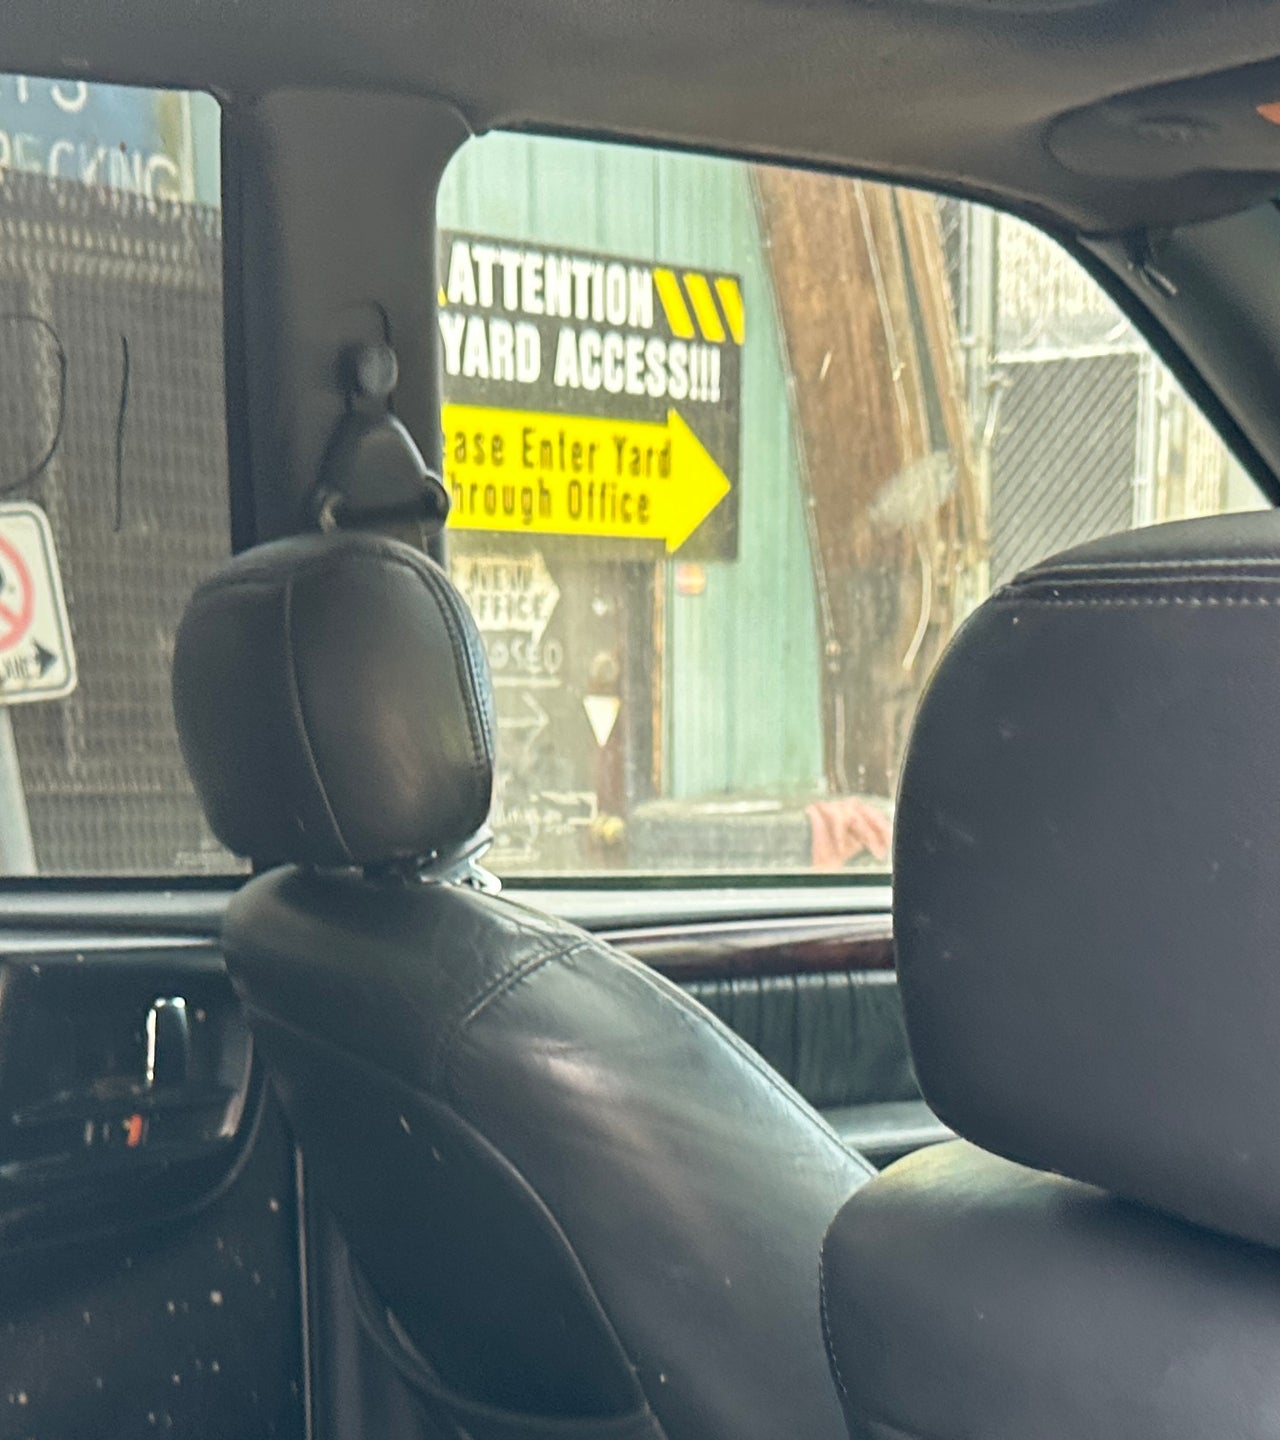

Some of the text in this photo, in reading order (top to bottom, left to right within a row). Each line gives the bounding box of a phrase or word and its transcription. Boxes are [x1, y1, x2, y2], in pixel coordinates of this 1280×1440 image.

[447, 240, 654, 329] ATTENTION
[439, 312, 720, 402] YARD ACCESS!!!
[521, 427, 597, 473] Enter
[612, 435, 672, 479] Yard
[568, 479, 650, 525] Office
